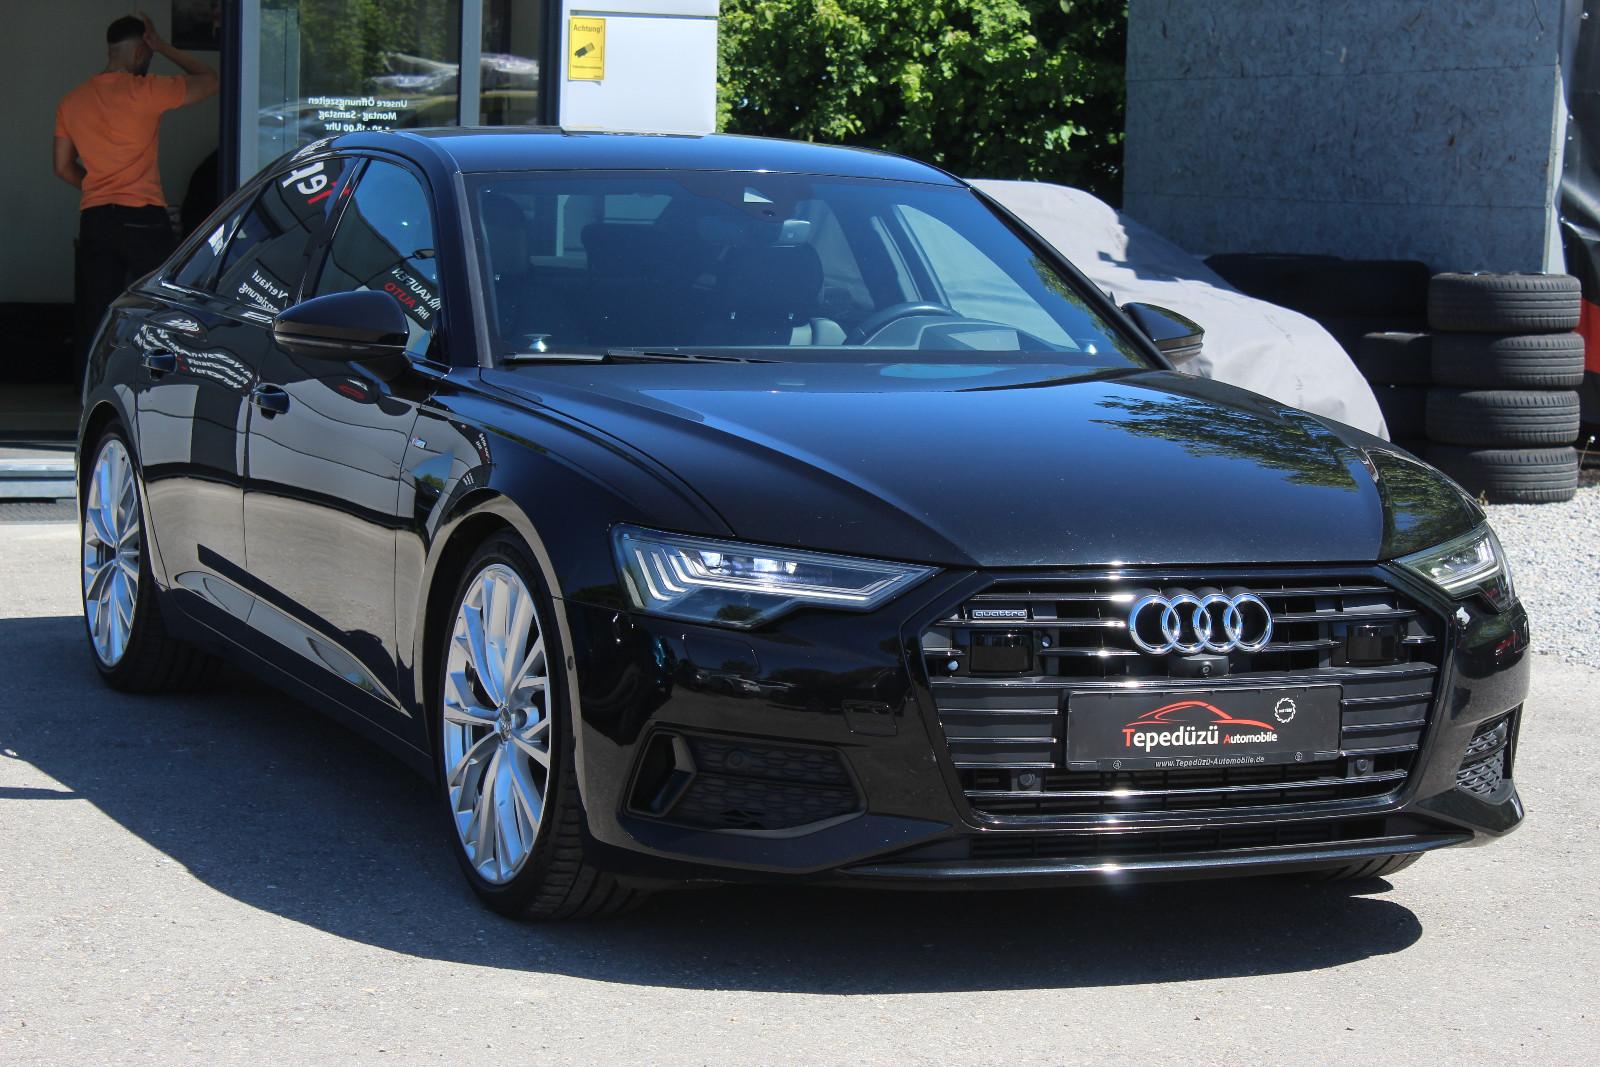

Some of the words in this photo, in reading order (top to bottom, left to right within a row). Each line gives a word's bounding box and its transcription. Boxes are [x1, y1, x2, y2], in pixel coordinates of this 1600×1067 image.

[573, 24, 603, 34] Achtung!
[1122, 726, 1219, 752] Tepedüzü
[1223, 732, 1277, 744] Automobile
[1155, 756, 1265, 768] www.Tepedüzü-Automobile.de
